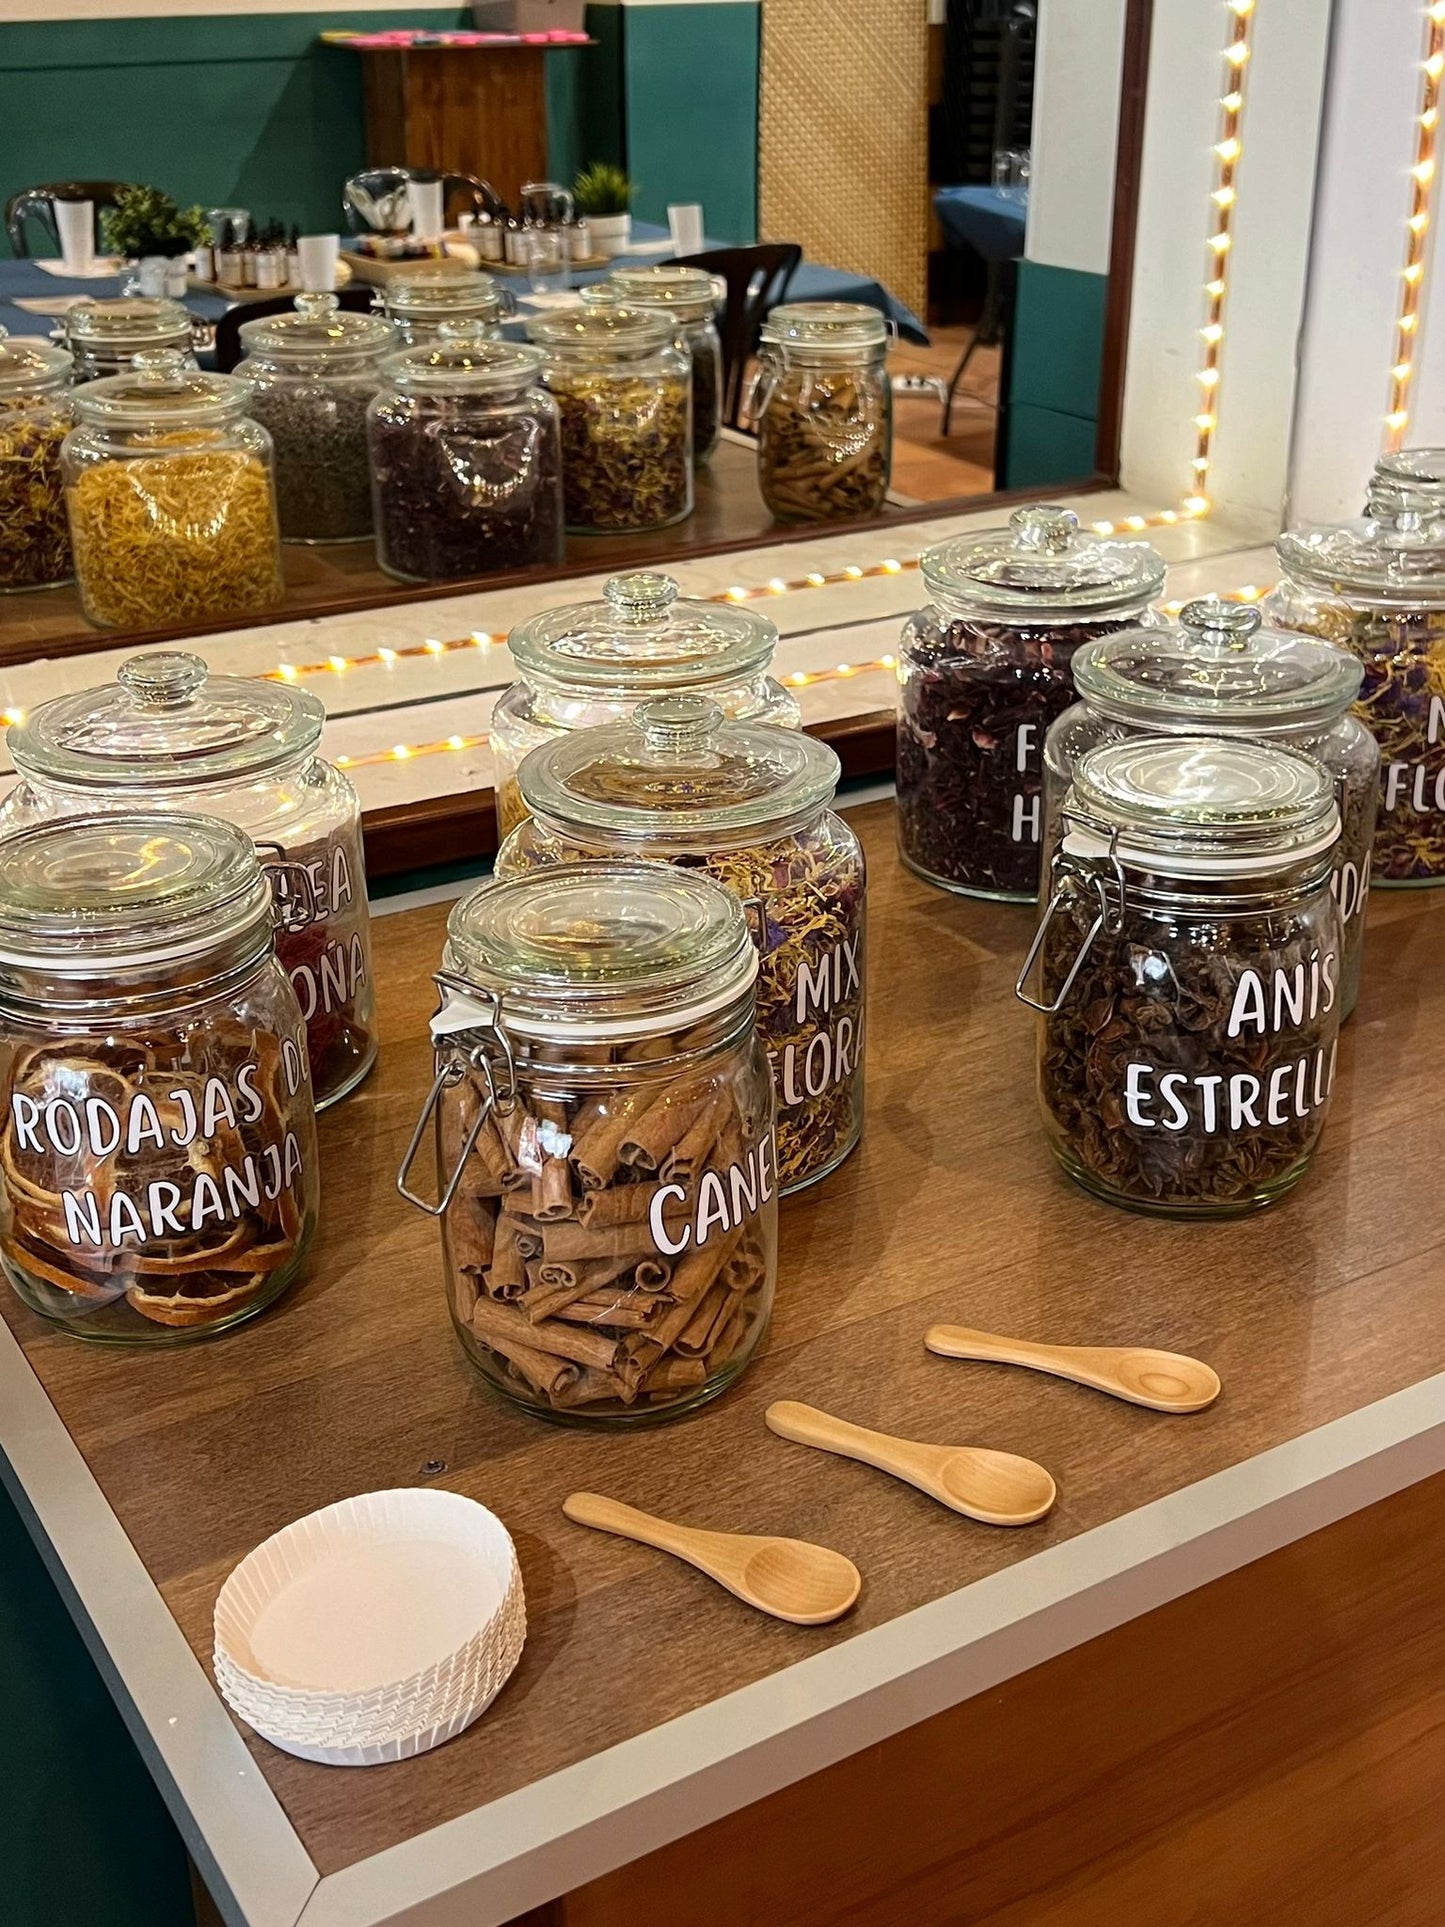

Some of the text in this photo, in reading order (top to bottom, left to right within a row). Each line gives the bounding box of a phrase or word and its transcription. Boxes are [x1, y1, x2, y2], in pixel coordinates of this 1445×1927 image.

[796, 929, 860, 1024] MIX
[12, 1064, 263, 1157] RODAJAS
[62, 1132, 304, 1248] NARANJA
